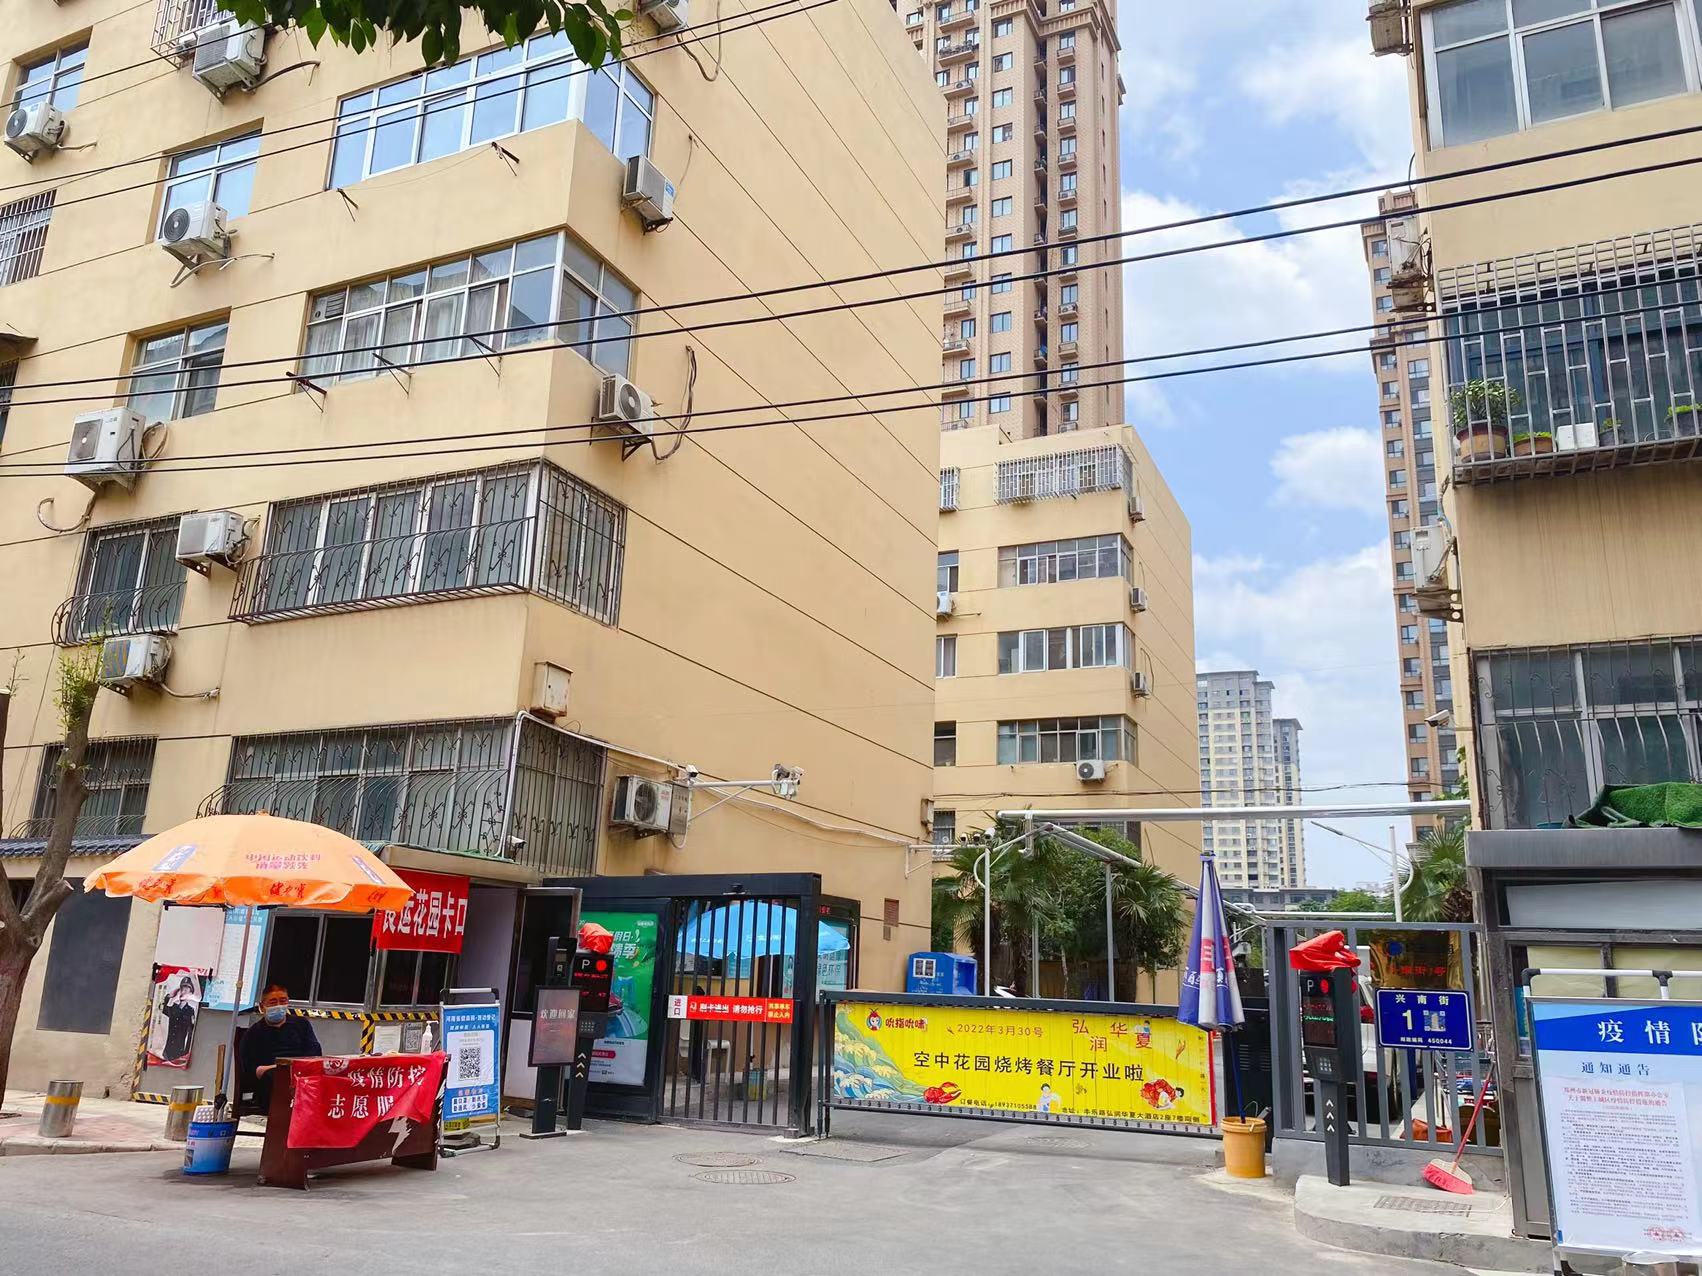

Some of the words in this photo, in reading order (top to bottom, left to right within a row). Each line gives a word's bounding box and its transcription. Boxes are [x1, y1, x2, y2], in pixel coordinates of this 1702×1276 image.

[582, 960, 590, 969] P
[1307, 980, 1314, 992] P
[1396, 994, 1449, 1005] 兴南街
[1402, 1010, 1413, 1030] 1
[957, 1023, 1044, 1037] 2022年3月30号
[913, 1051, 1144, 1082] 空中花园烧烤餐厅开业啦
[1581, 1061, 1650, 1076] 通知通告
[348, 1064, 427, 1088] 疫情防控
